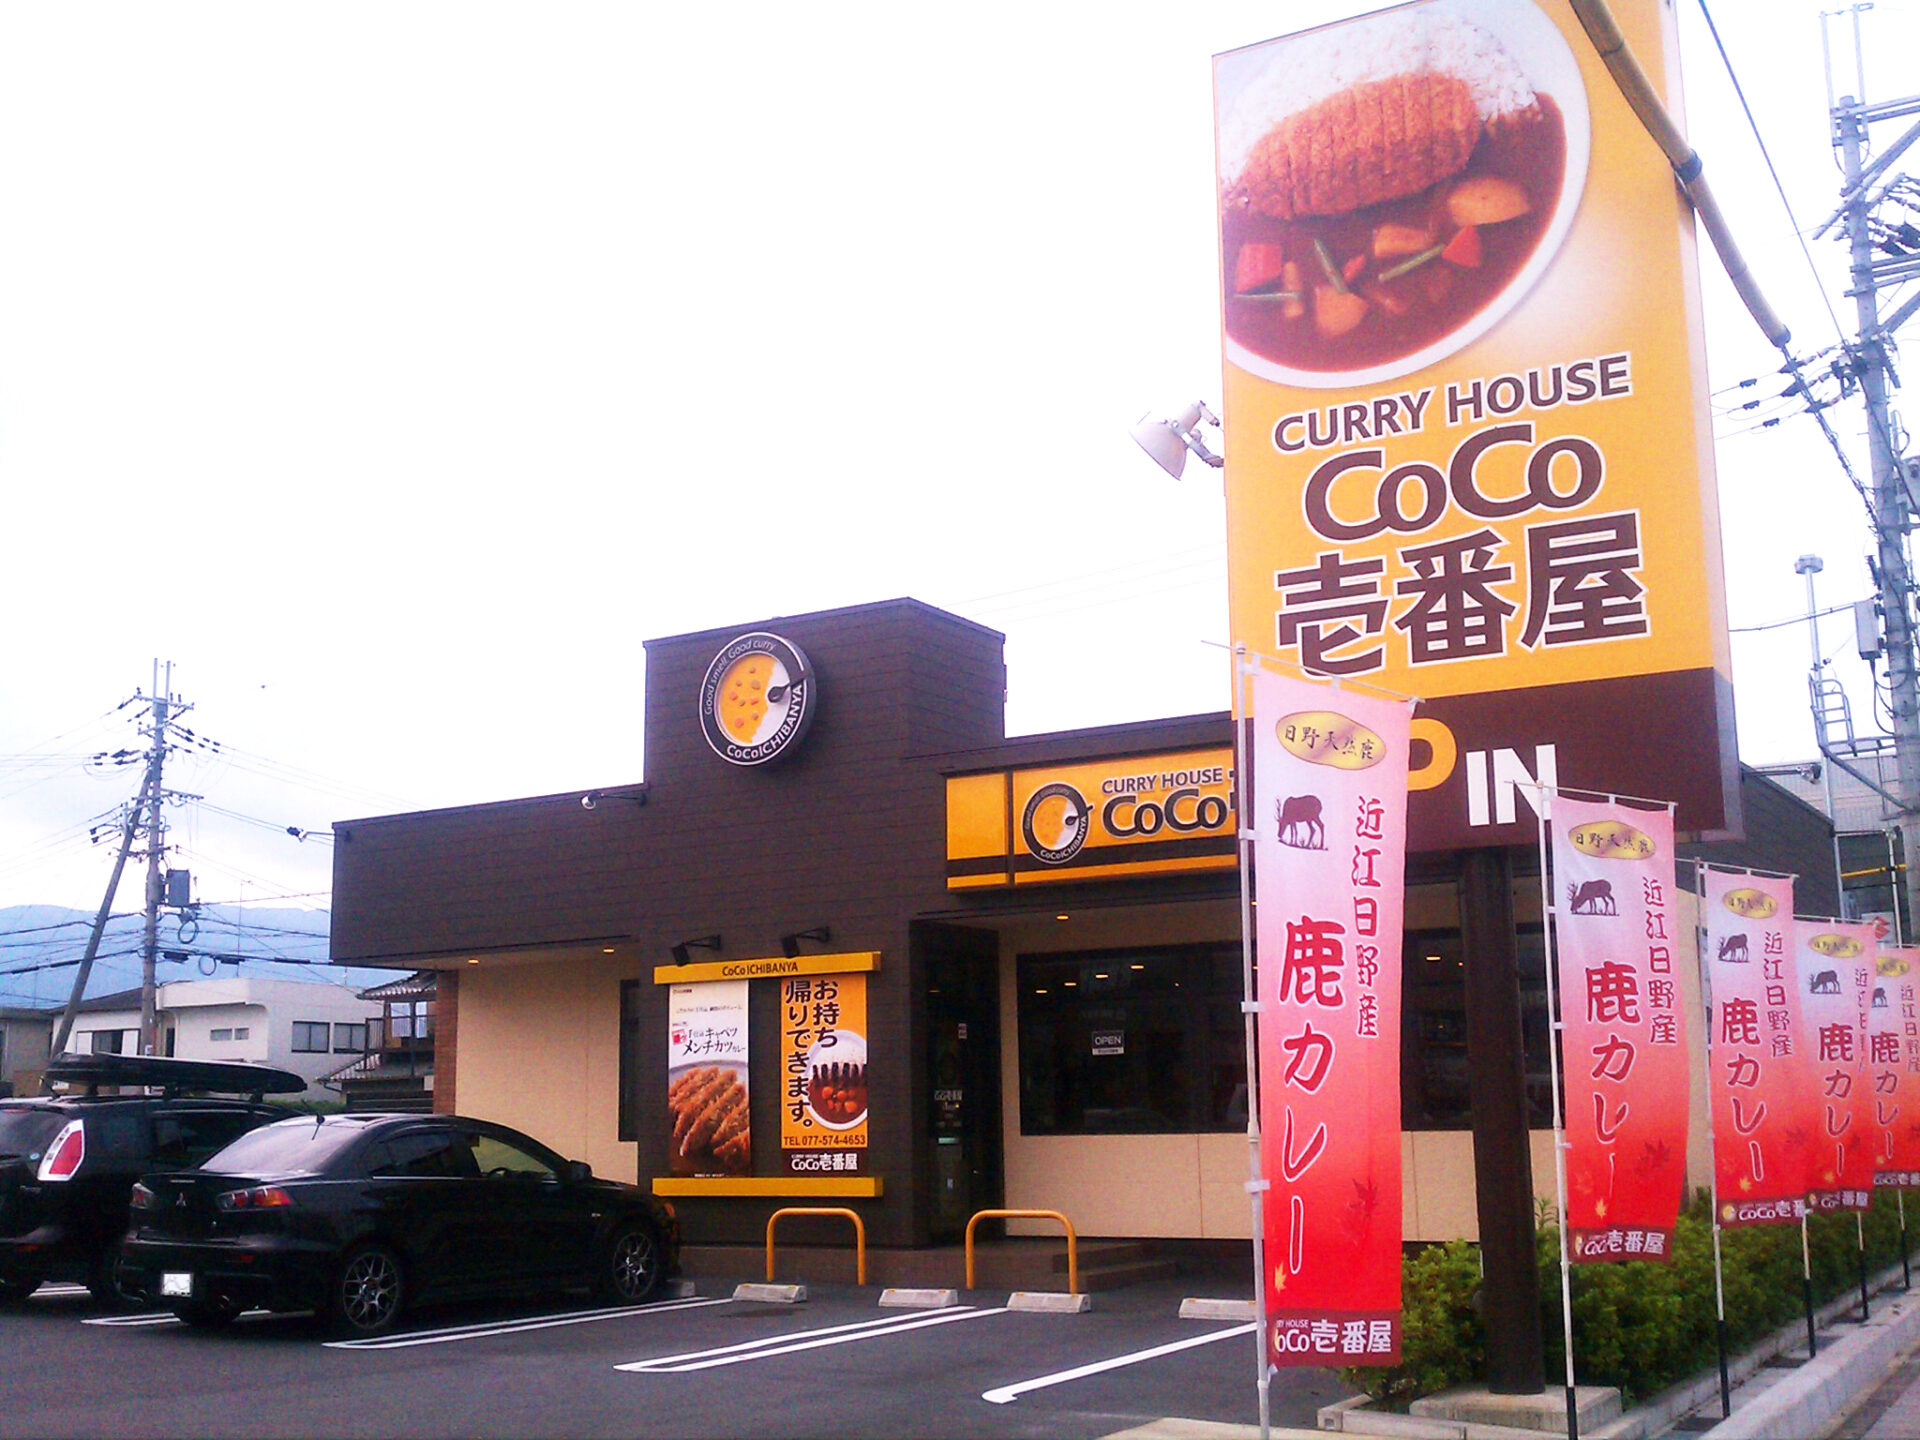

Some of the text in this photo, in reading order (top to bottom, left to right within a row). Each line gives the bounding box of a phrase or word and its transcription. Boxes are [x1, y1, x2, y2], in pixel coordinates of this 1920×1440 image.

[1274, 355, 1630, 451] CURRY HOUSE
[1304, 423, 1604, 542] CoCo
[1275, 512, 1650, 677] 壱番屋
[1101, 767, 1223, 795] CURRY HOUSE
[1102, 788, 1234, 838] CoCo
[1465, 743, 1558, 827] IN
[1351, 795, 1386, 1037] 近江日野産
[785, 980, 814, 1129] 帰りできます。
[813, 979, 840, 1049] お持ち
[1094, 1035, 1122, 1046] OPEN
[1279, 915, 1347, 1275] 鹿カレー
[1722, 996, 1766, 1182] 鹿カレー
[783, 1136, 800, 1146] TEL
